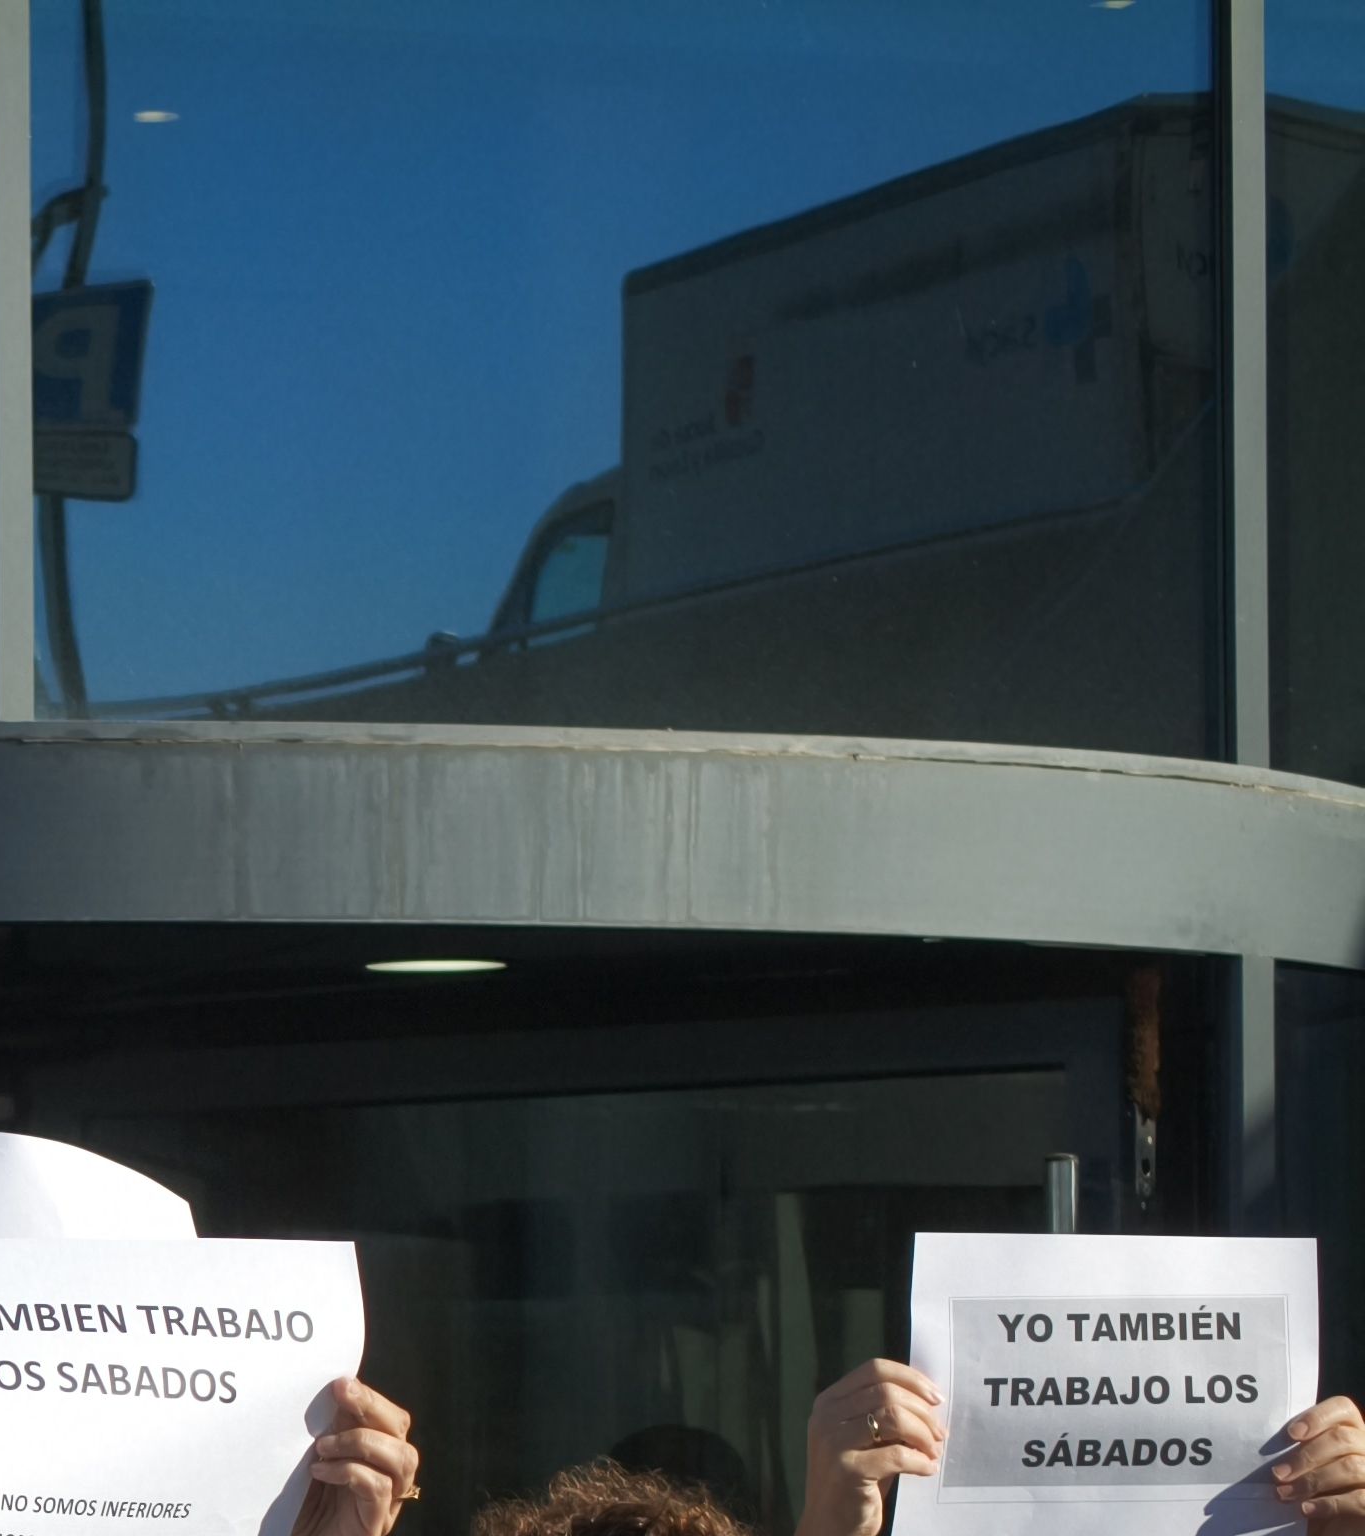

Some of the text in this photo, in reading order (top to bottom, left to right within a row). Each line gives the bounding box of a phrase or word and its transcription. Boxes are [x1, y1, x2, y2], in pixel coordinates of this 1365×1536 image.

[136, 1305, 313, 1342] TRABAJO
[998, 1305, 1240, 1342] YO TAMBIÉN
[57, 1362, 236, 1404] SABADOS
[984, 1375, 1258, 1406] TRABAJO LOS
[1022, 1433, 1212, 1467] SÁBADOS
[1, 1494, 191, 1518] NO SOMOS INFERIORES
